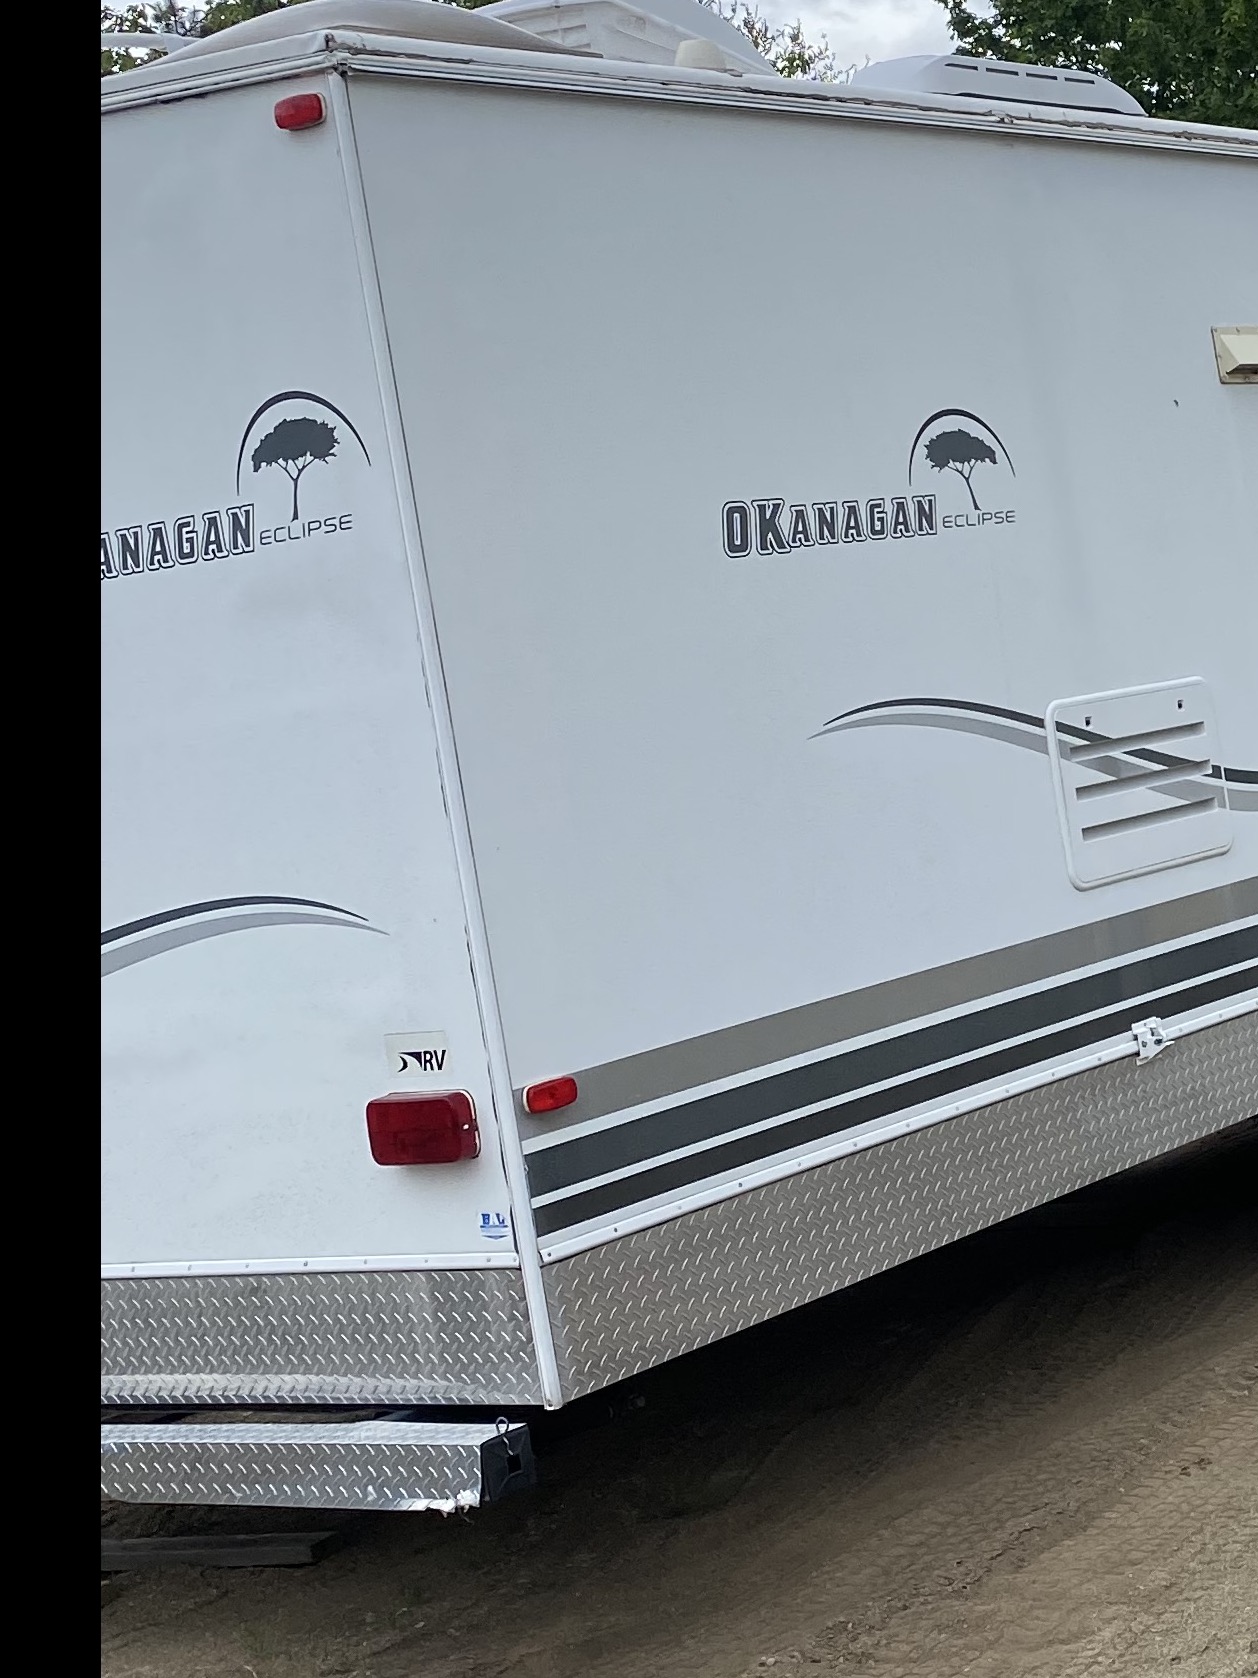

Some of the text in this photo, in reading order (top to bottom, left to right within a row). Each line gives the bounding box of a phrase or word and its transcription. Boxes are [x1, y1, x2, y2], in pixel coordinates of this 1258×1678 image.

[259, 513, 354, 546] ECLIPSE
[722, 494, 1016, 559] OKANAGAN ECLIPSE
[422, 1049, 447, 1072] RV
